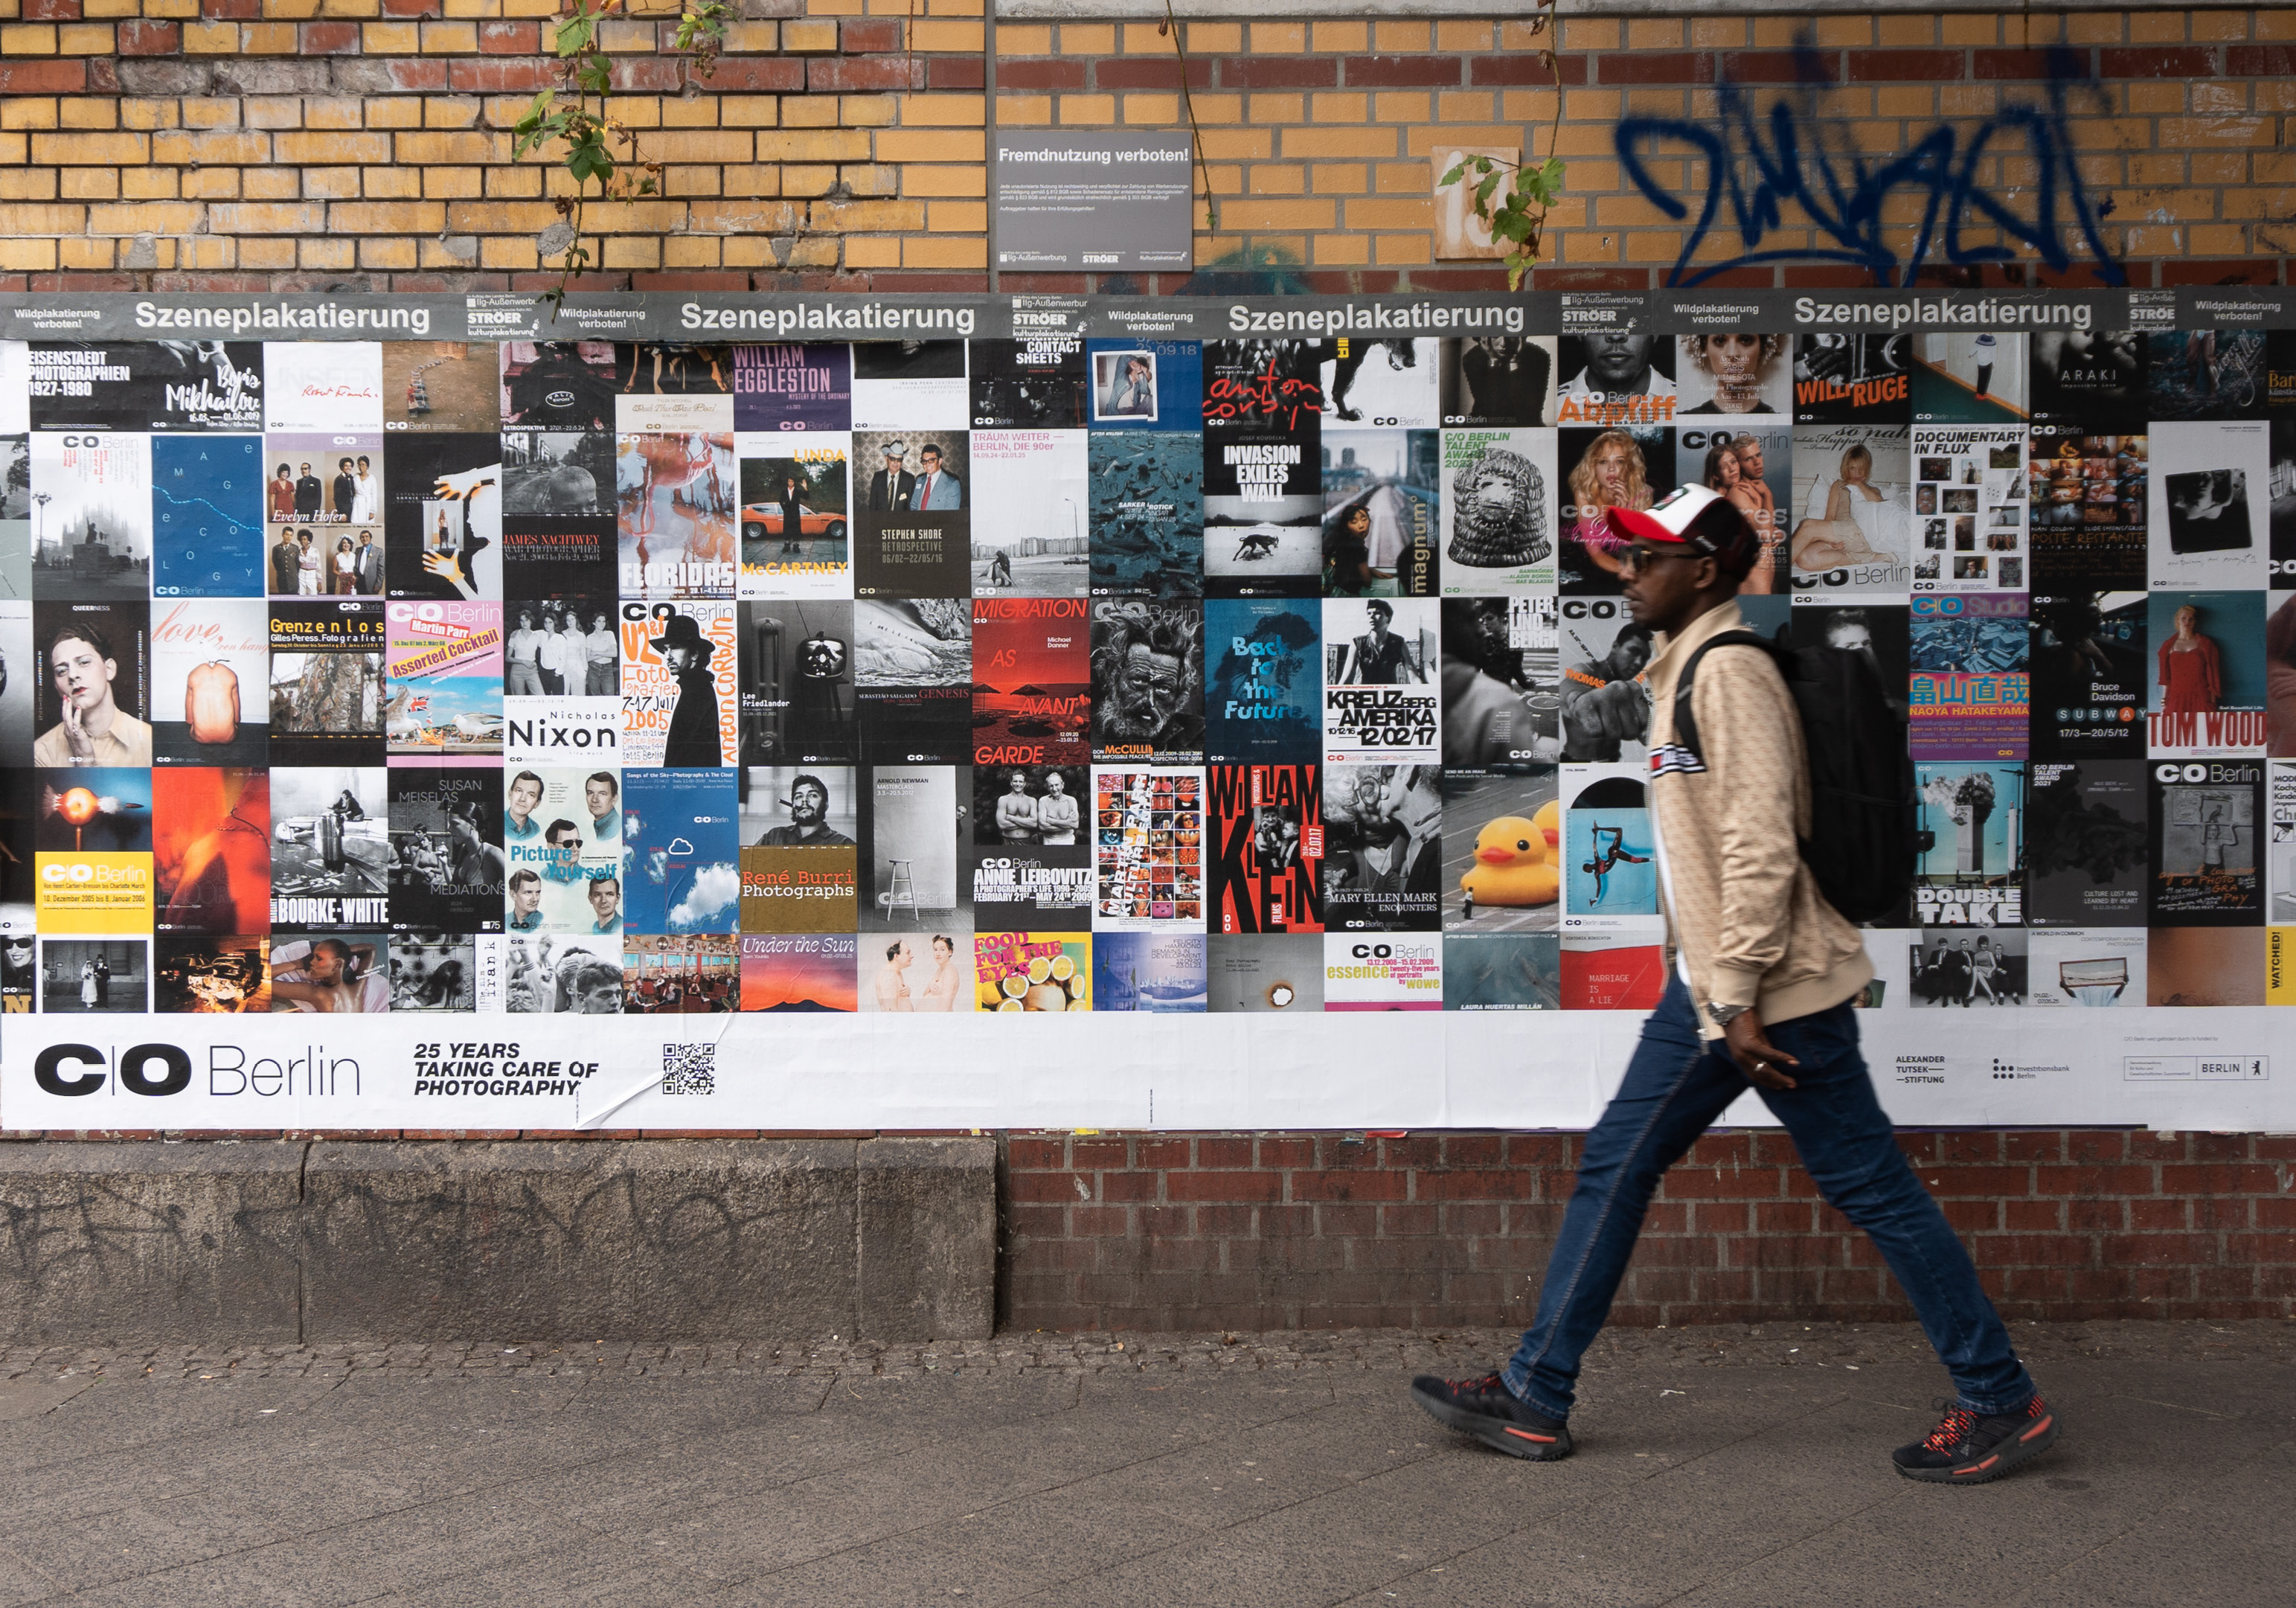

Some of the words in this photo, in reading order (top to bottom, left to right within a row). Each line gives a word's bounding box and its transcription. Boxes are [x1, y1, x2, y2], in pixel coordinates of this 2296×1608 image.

[999, 148, 1111, 164] Fremdnutzung
[1116, 148, 1188, 161] verboten!
[1083, 254, 1118, 263] STRÖER
[14, 309, 100, 320] Wildplakatierung
[559, 308, 646, 320] Wildplakatierung
[1674, 304, 1759, 315] Wildplakatierung
[1795, 297, 2091, 330] Szeneplakatierung
[2196, 301, 2281, 313] Wildplakatierung
[135, 301, 429, 334] Szeneplakatierung
[468, 311, 522, 324] STRÖER
[681, 303, 975, 335] Szeneplakatierung
[1013, 313, 1067, 325] STRÖER
[1108, 311, 1193, 322] Wildplakatierung
[1229, 303, 1524, 336] Szeneplakatierung
[1562, 310, 1617, 321] STRÖER
[1693, 314, 1740, 324] verboten!
[2214, 312, 2263, 321] verboten!
[33, 319, 82, 328] verboten!
[579, 319, 626, 328] verboten!
[1127, 321, 1175, 330] verboten!
[1027, 341, 1081, 353] CONTACT
[28, 350, 107, 365] EISENSTAEDT
[732, 346, 804, 368] WILLIAM
[1016, 353, 1062, 364] SHEETS
[28, 366, 130, 381] PHOTOGRAPHIEN
[734, 368, 830, 393] EGGLESTON
[1797, 381, 1850, 406] WILLI
[1853, 375, 1908, 407] RUGE
[973, 432, 1009, 441] TRÄUM
[1012, 433, 1049, 441] WEITER
[1914, 432, 2025, 443] DOCUMENTARY
[973, 443, 1009, 452] BERLIN,
[1013, 443, 1030, 451] DIE
[1033, 442, 1054, 451] 90er
[1914, 444, 1930, 454] IN
[1934, 443, 1972, 455] FLUX
[794, 449, 846, 462] LINDA
[1224, 446, 1301, 464] INVASION
[1237, 465, 1289, 484] EXILES
[1240, 484, 1285, 502] WALL
[272, 510, 310, 525] Evelyn
[312, 509, 344, 522] Hofer
[503, 535, 538, 545] JAMES
[541, 535, 600, 545] NACHTWEY
[882, 529, 915, 539] STEPHEN
[918, 529, 942, 539] SHORE
[882, 541, 942, 552] RETROSPECTIVE
[621, 563, 734, 587] FLORIDAS
[741, 562, 847, 575] McCARTNEY
[973, 599, 1087, 618] MIGRATION
[1510, 595, 1554, 613] PETER
[270, 618, 384, 633] Grenzenlos
[411, 621, 445, 635] Martin
[446, 626, 469, 638] Parr
[271, 634, 291, 642] Gilles
[322, 633, 384, 644] Fotografien
[392, 647, 447, 678] Assorted
[448, 630, 499, 658] Cocktail
[990, 650, 1016, 667] AS
[919, 688, 969, 699] GENESIS
[2091, 693, 2135, 701] Davidson
[1019, 697, 1079, 715] AVANT
[1910, 708, 1949, 716] NAOYA
[1952, 708, 2029, 716] HATAKEYAMA
[551, 711, 615, 720] Nicholas
[1339, 709, 1436, 727] AMERIKA
[510, 719, 616, 747] Nixon
[2148, 712, 2197, 747] TOM
[2205, 712, 2267, 747] WOOD
[975, 746, 1044, 764] GARDE
[439, 780, 482, 791] SUSAN
[400, 792, 458, 803] MEISELAS
[511, 845, 571, 862] Picture
[547, 863, 617, 880] Yourself
[743, 869, 789, 884] René
[798, 869, 855, 884] Burri
[974, 869, 1016, 885] ANNIE
[1021, 868, 1092, 885] LEIBOVITZ
[742, 883, 854, 900] Photographs
[1330, 893, 1360, 903] MARY
[1364, 893, 1399, 903] ELLEN
[1403, 892, 1437, 902] MARK
[1917, 889, 2021, 903] DOUBLE
[1379, 903, 1437, 912] ENCOUNTERS
[1917, 903, 2021, 923] TAKE
[743, 937, 791, 953] Under
[795, 936, 819, 953] the
[821, 938, 855, 953] Sun
[975, 932, 1029, 953] FOOD
[975, 949, 1017, 968] FOR
[1020, 941, 1063, 958] THE
[2272, 932, 2280, 989] WATCHED!
[977, 961, 1031, 983] EYES
[1327, 966, 1389, 978] essence
[1589, 974, 1629, 982] MARRIAGE
[1589, 985, 1599, 993] IS
[414, 1043, 440, 1058] 25
[449, 1043, 520, 1058] YEARS
[210, 1045, 360, 1096] Berlin
[414, 1062, 495, 1077] TAKING
[503, 1062, 561, 1077] CARE
[568, 1061, 599, 1078] OF
[2202, 1063, 2240, 1073] BERLIN
[414, 1080, 582, 1096] PHOTOGRAPHY
